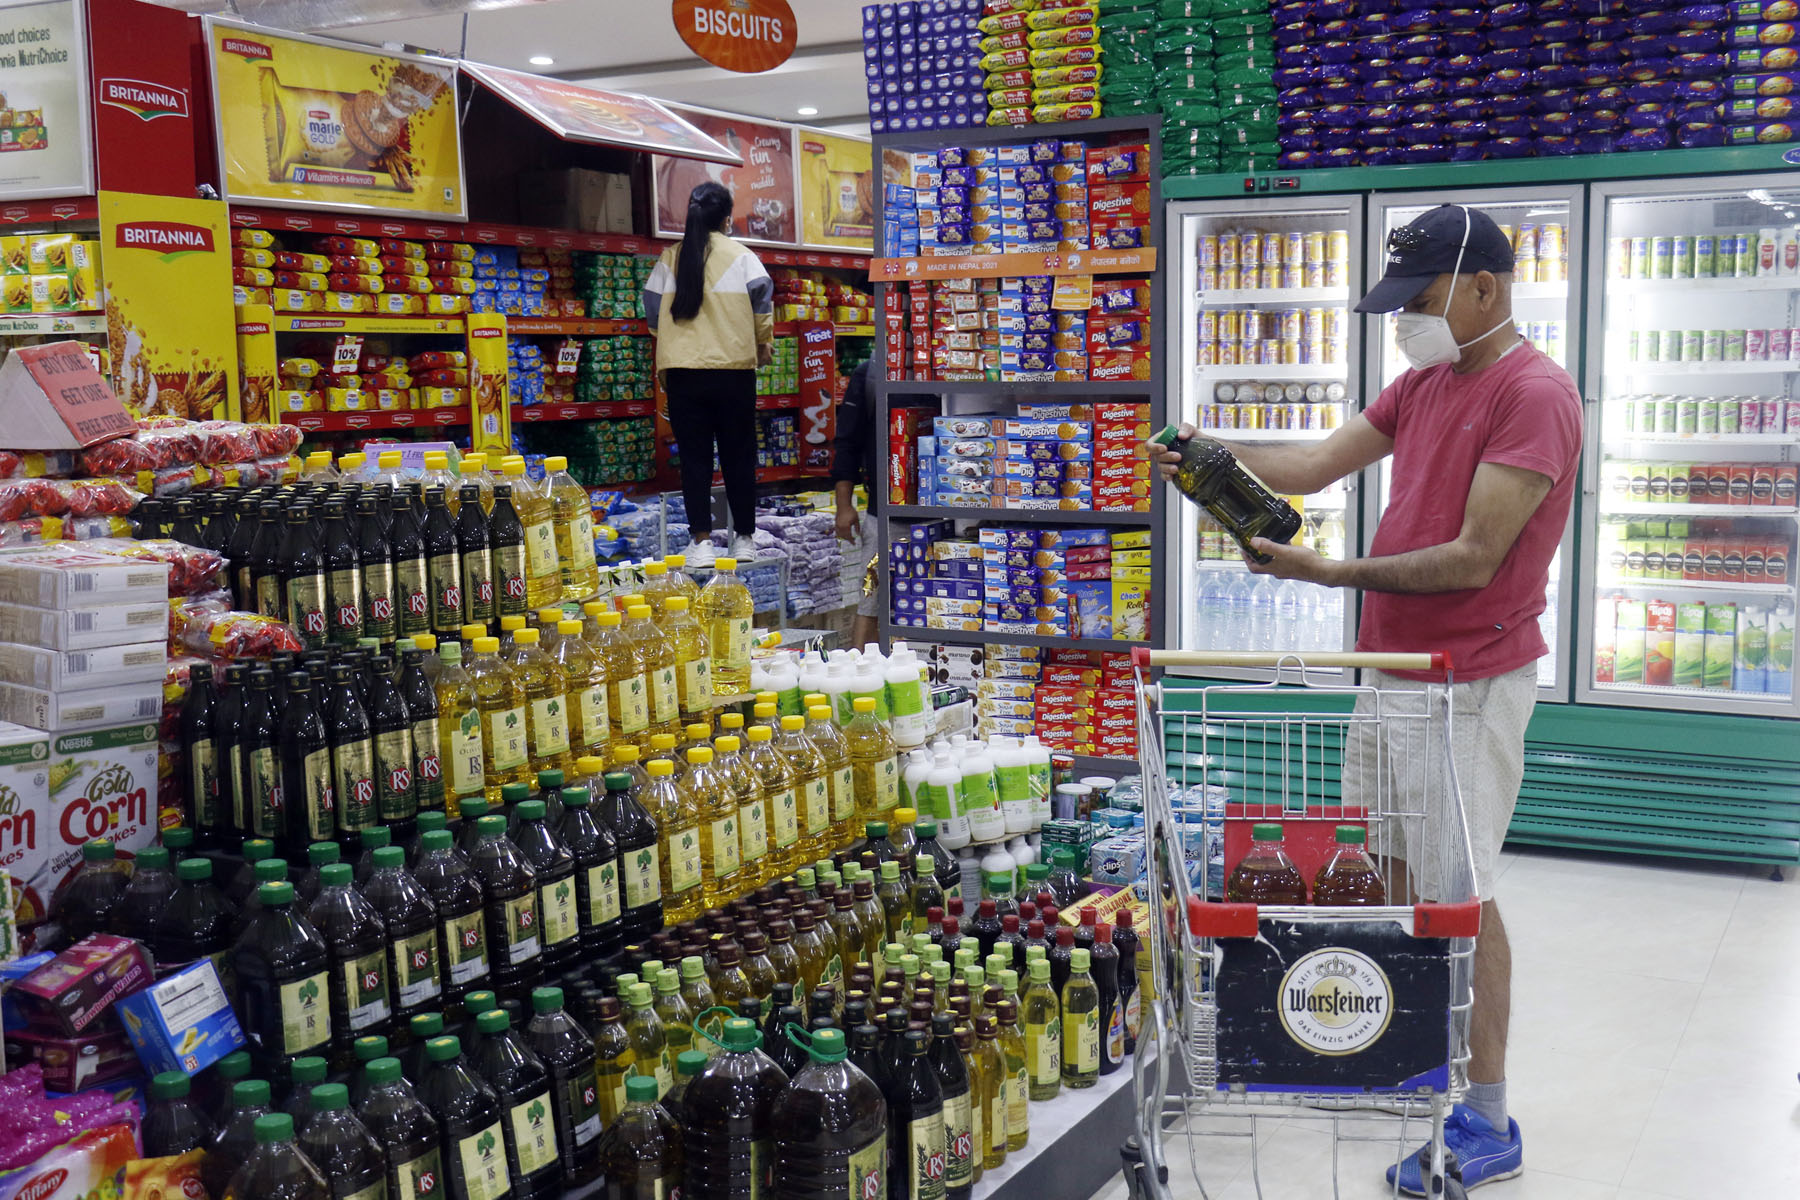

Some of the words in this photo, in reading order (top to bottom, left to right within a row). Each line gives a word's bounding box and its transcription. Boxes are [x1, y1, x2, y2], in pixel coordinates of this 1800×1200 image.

[694, 6, 783, 43] BISCUITS
[18, 28, 50, 43] choices
[226, 41, 268, 57] BRITANNIA
[19, 50, 68, 67] NutriChoice
[109, 84, 179, 109] BRITANNIA
[309, 121, 341, 136] marie
[310, 133, 336, 145] GOLD
[749, 146, 772, 166] fun
[295, 168, 305, 181] 10
[307, 171, 339, 183] Vitamins
[346, 175, 373, 185] Minerals
[1093, 196, 1131, 210] Digestive
[235, 215, 258, 223] BRITANNIA
[124, 227, 205, 247] BRITANNIA
[1388, 255, 1402, 264] IKE
[237, 323, 268, 333] BRITANNIA
[474, 329, 501, 337] BRITANNIA
[804, 330, 832, 343] Treat
[337, 348, 357, 360] 10%
[561, 351, 577, 361] 10%
[39, 356, 64, 375] BUY
[64, 352, 88, 372] ONE
[803, 357, 824, 369] fun
[804, 372, 827, 384] middle
[1093, 365, 1131, 377] Digestive
[60, 387, 84, 408] GET
[82, 383, 108, 401] ONE
[1033, 409, 1069, 420] Digestive
[1102, 409, 1134, 419] Digestive
[77, 418, 106, 438] FREE
[103, 412, 131, 431] ITEMS
[1020, 426, 1057, 438] Digestive
[1101, 429, 1134, 439] Digestive
[1101, 447, 1133, 458] Digestive
[892, 453, 900, 486] Digestive
[1101, 467, 1133, 477] Digestive
[1099, 486, 1131, 495] Digestive
[483, 583, 493, 601] RS
[509, 579, 525, 595] RS
[411, 593, 427, 613] RS
[447, 588, 460, 607] RS
[1120, 592, 1140, 600] Choco
[374, 599, 391, 617] RS
[1126, 601, 1144, 609] Rolls
[307, 612, 325, 634] RS
[340, 606, 359, 625] RS
[1057, 653, 1088, 662] Digestive
[1108, 660, 1131, 669] Digesti
[1050, 674, 1080, 682] Digestive
[1042, 695, 1073, 703] Digestive
[1103, 699, 1134, 708] Digestive
[1042, 712, 1073, 721] Digestive
[1101, 718, 1133, 726] Digestive
[551, 727, 559, 738] RS
[1042, 729, 1073, 738] Digestive
[1102, 735, 1134, 744] Digestive
[509, 739, 517, 751] RS
[424, 758, 440, 778] RS
[89, 771, 129, 803] Gold
[393, 770, 410, 790] RS
[357, 782, 374, 798] RS
[59, 787, 147, 846] Corn
[51, 848, 83, 874] CRUNCHY
[686, 861, 692, 872] RS
[1098, 860, 1126, 871] eclipse
[522, 911, 533, 925] RS
[465, 930, 478, 945] RS
[414, 951, 428, 966] RS
[365, 972, 379, 988] RS
[1297, 970, 1312, 985] SEIT
[1360, 971, 1375, 987] 1753
[1289, 986, 1382, 1016] Warsteiner
[73, 988, 116, 1032] Strawberry
[1298, 1019, 1311, 1035] DAS
[1313, 1032, 1344, 1044] EINZIG
[1346, 1019, 1373, 1041] WAHRE
[584, 1088, 595, 1102] RS
[958, 1133, 971, 1156] RS
[930, 1154, 944, 1177] RS
[19, 1170, 63, 1200] Tiffany
[419, 1173, 434, 1191] RS
[864, 1170, 879, 1198] RS
